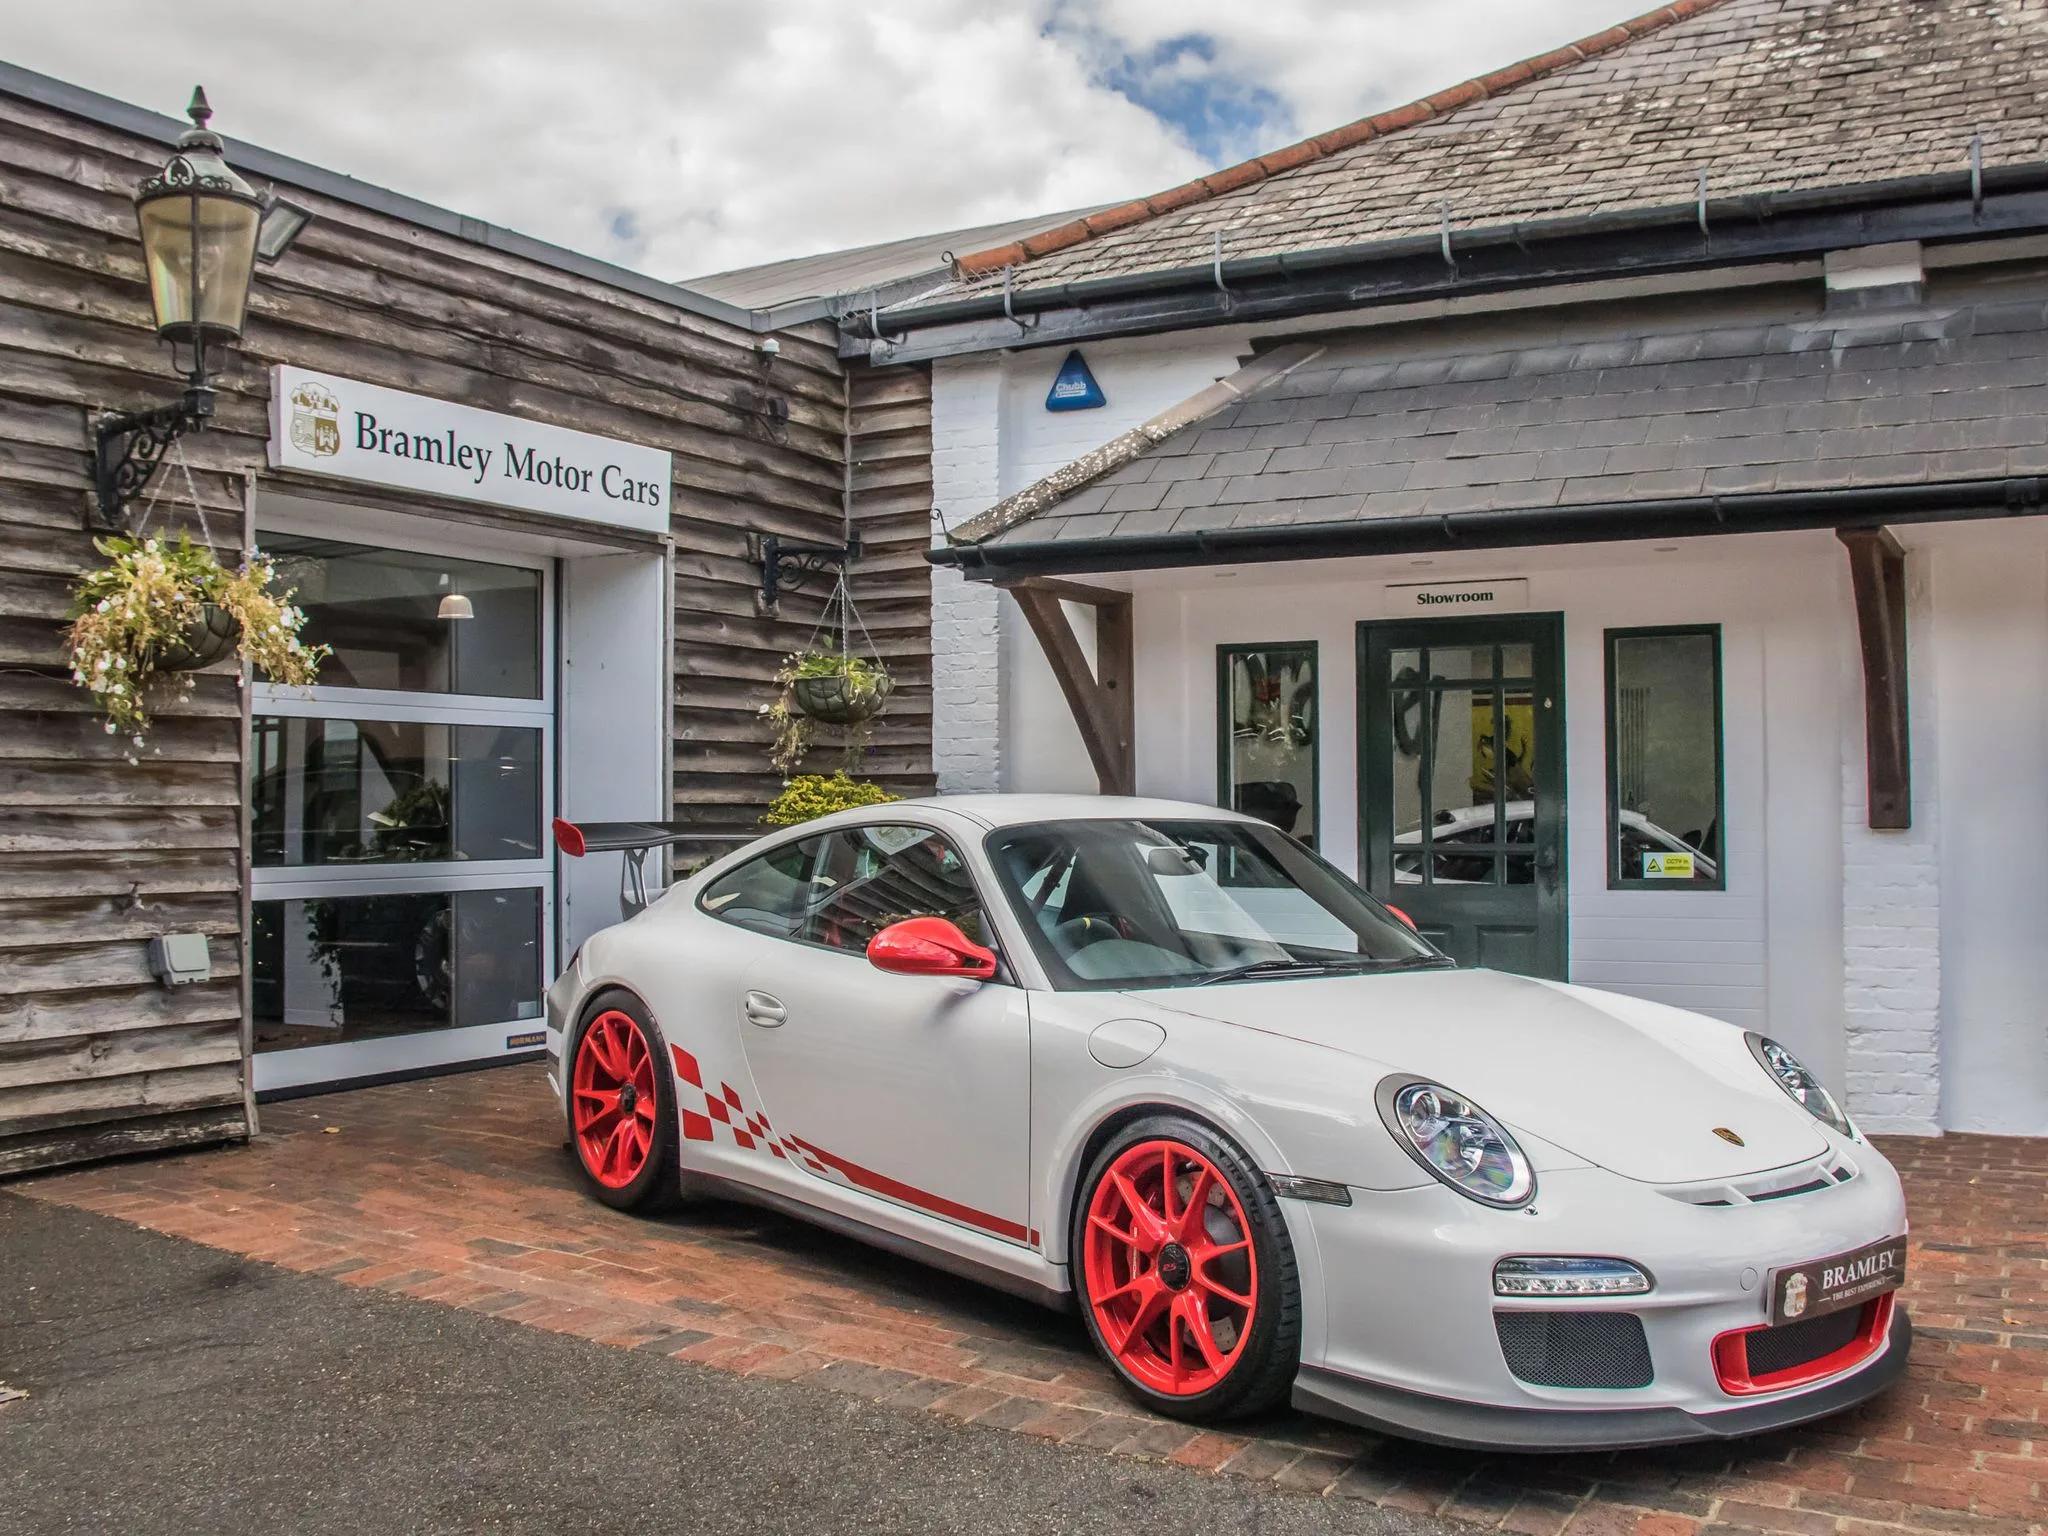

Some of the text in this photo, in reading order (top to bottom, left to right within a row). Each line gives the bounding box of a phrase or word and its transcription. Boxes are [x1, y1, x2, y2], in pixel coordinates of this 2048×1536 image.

[353, 410, 660, 506] Bramley Motor Cars
[1416, 591, 1494, 605] Showroom
[1822, 1249, 1896, 1290] BRAMLEY
[1832, 1290, 1844, 1301] THE
